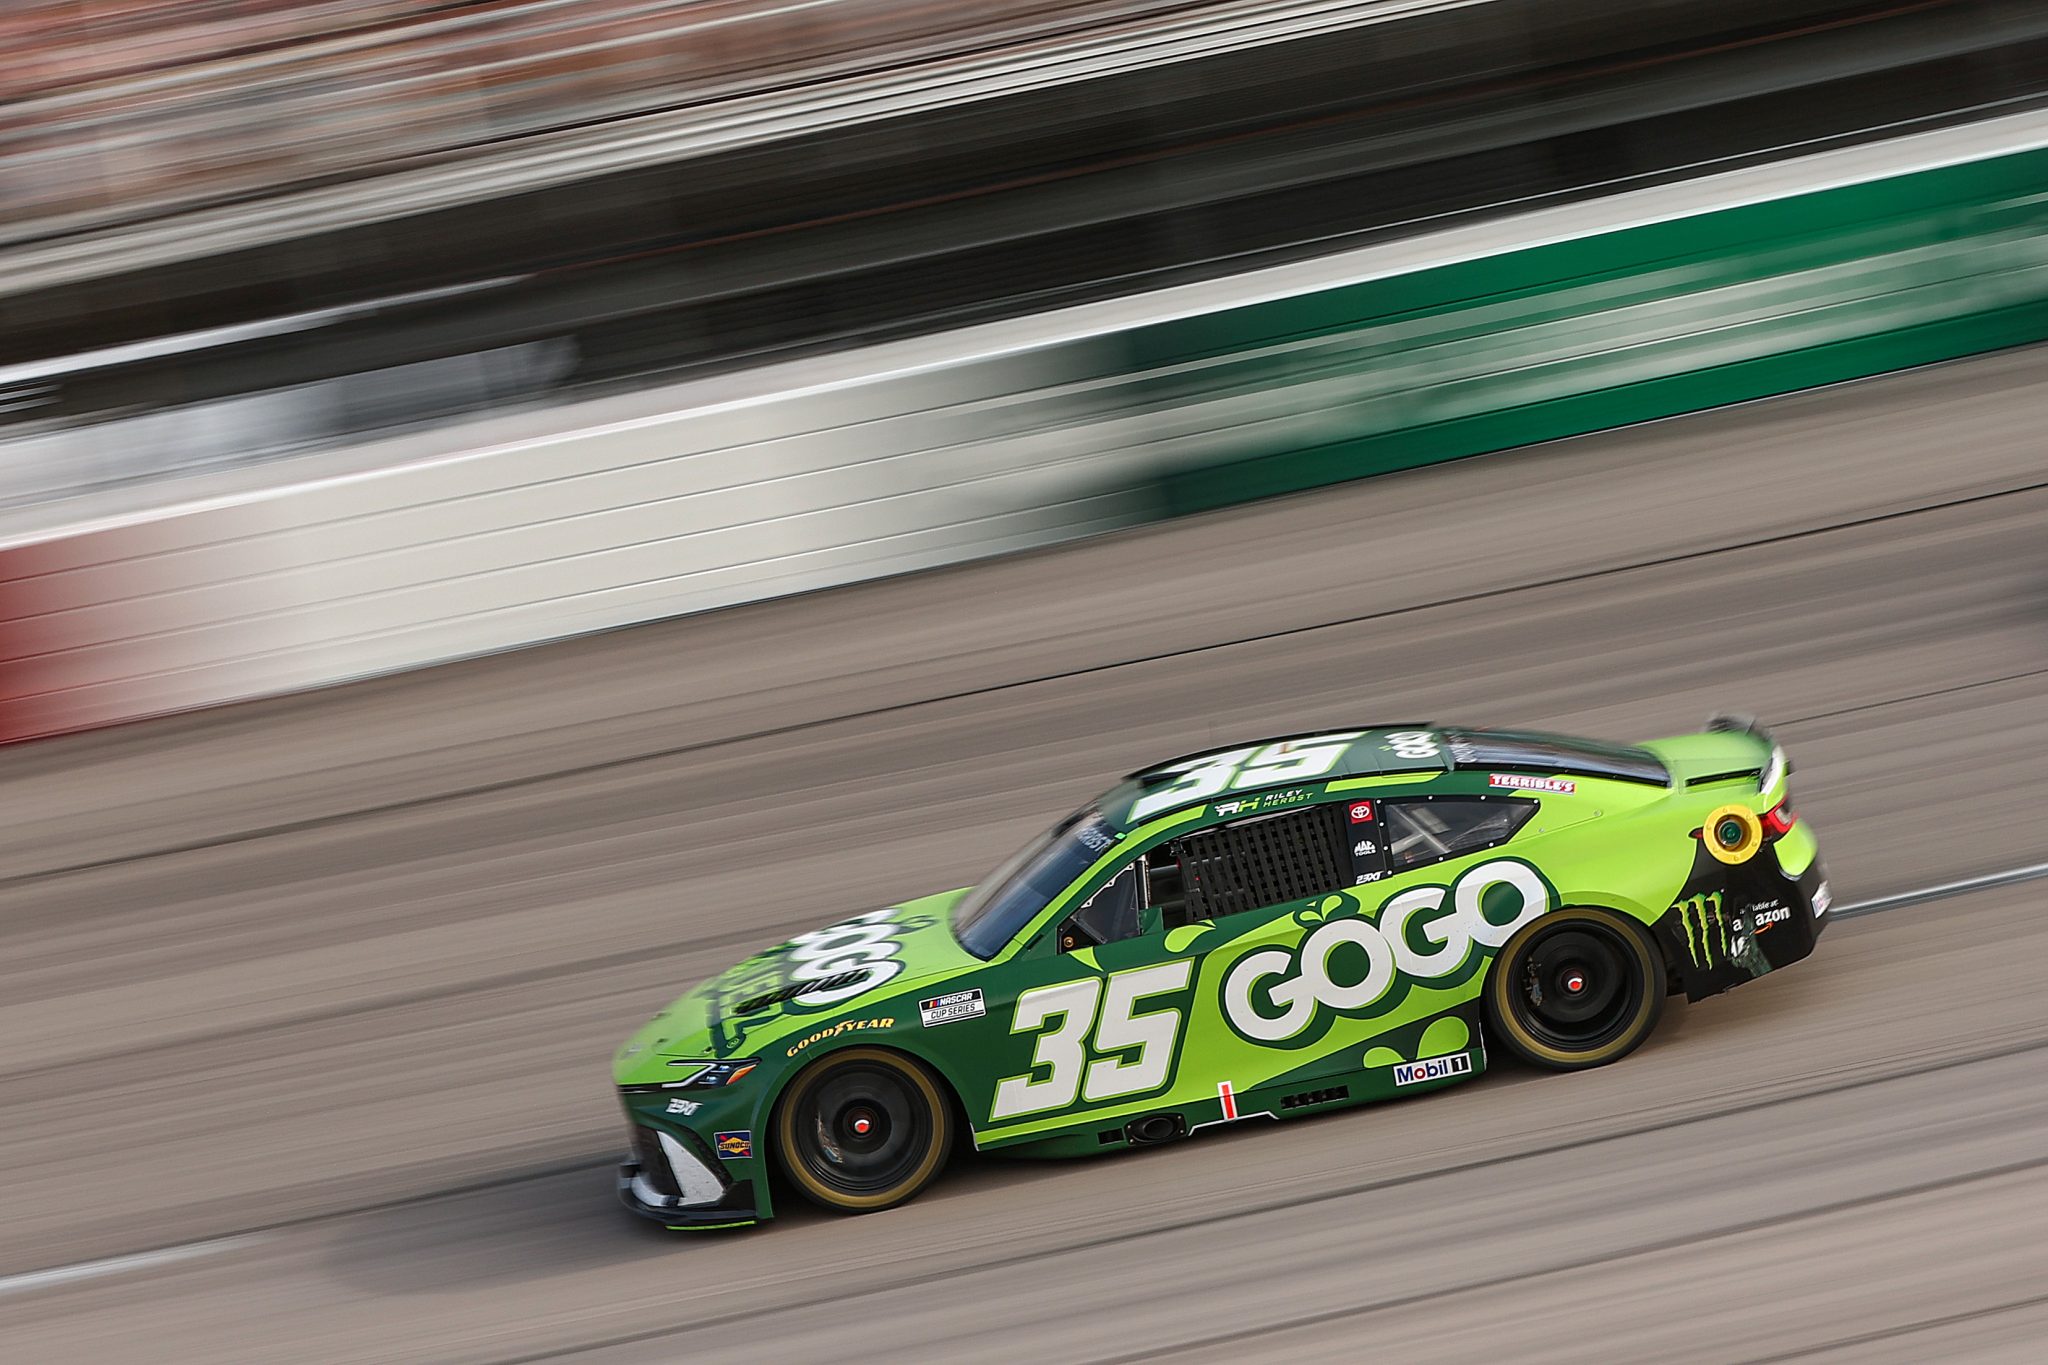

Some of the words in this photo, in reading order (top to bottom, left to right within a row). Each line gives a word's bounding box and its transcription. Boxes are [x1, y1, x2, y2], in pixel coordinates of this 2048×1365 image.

[1127, 731, 1372, 822] 35
[1492, 775, 1575, 792] TERRIBLE'S
[1263, 793, 1313, 807] HERBST
[1265, 789, 1303, 801] RILEY
[1732, 906, 1790, 932] aazon
[1225, 861, 1546, 1040] GOGO
[940, 992, 973, 1006] NASCAR
[931, 1008, 947, 1019] CUP
[948, 1003, 976, 1016] SERIES
[786, 1018, 895, 1057] GOODYEAR
[989, 957, 1194, 1121] 35
[1396, 1059, 1449, 1083] Mobil
[719, 1141, 751, 1150] SUNOCO
